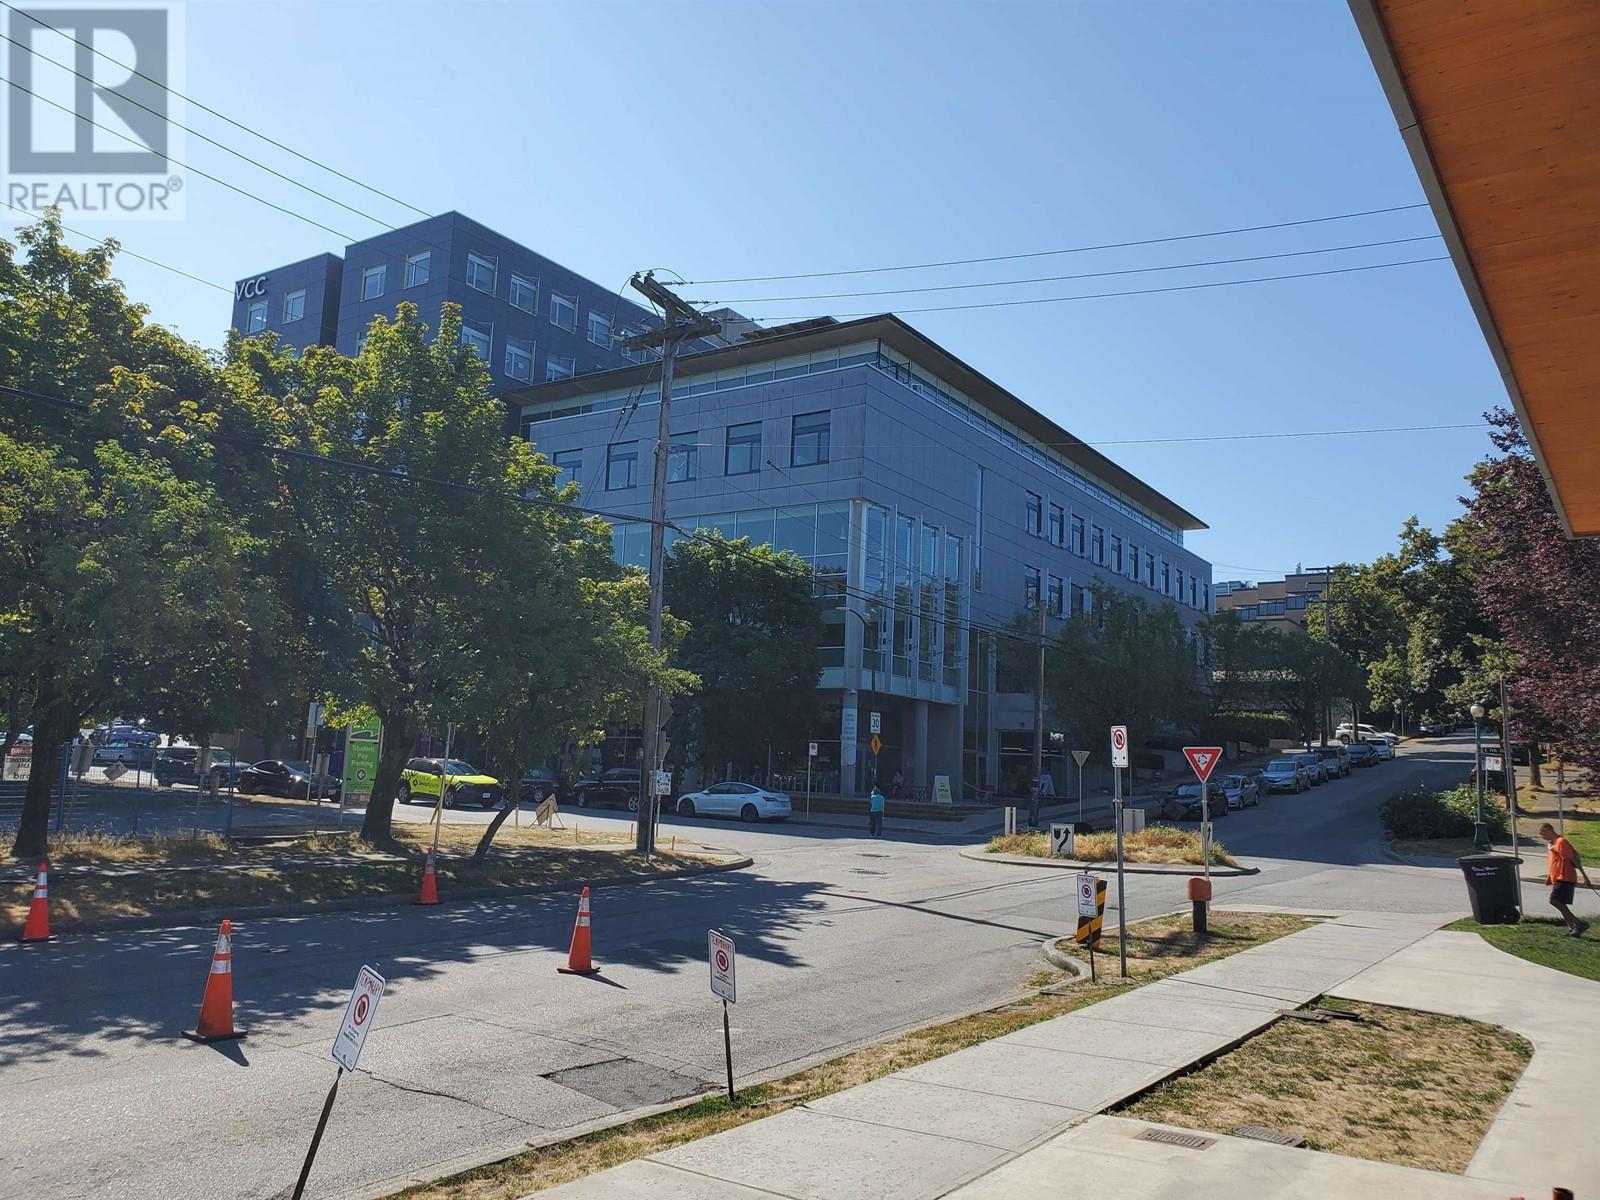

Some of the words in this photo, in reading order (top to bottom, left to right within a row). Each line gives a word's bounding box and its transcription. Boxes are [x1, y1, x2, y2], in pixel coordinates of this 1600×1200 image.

[235, 276, 266, 301] VCC
[872, 718, 879, 728] 30
[352, 745, 375, 753] Student
[357, 752, 369, 761] Pay
[351, 760, 374, 768] Parking
